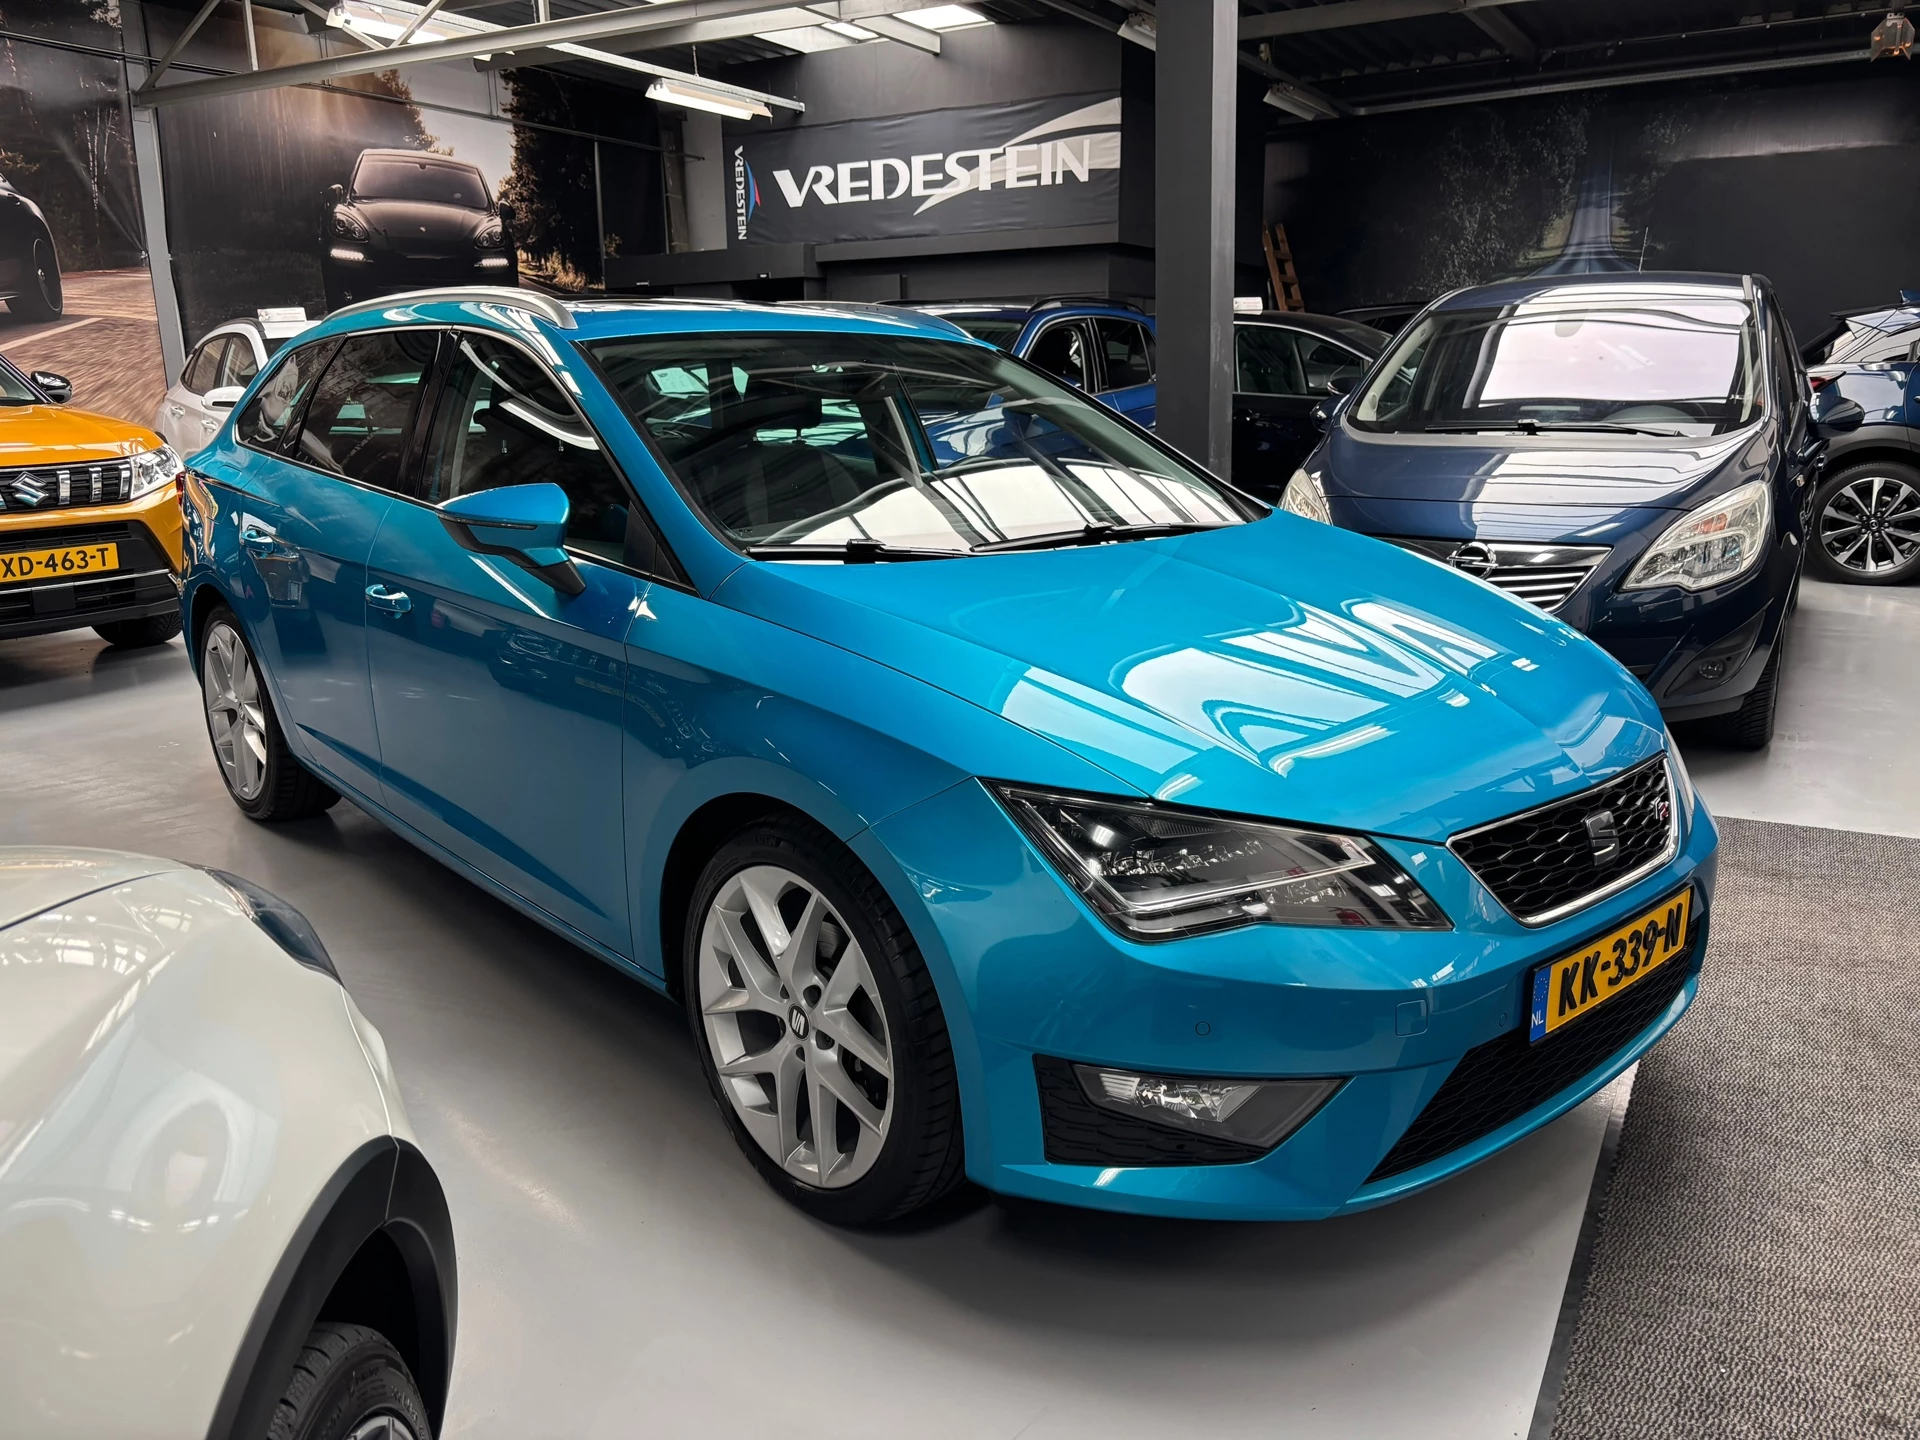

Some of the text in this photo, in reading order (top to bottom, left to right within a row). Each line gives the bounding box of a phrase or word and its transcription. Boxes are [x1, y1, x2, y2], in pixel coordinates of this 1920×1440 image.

[734, 145, 748, 240] VREDESTEIN
[772, 139, 1090, 208] VREDESTEIN
[1, 547, 109, 578] XD-463-T
[1558, 903, 1683, 1017] KK-339-N
[1531, 1012, 1544, 1029] NL
